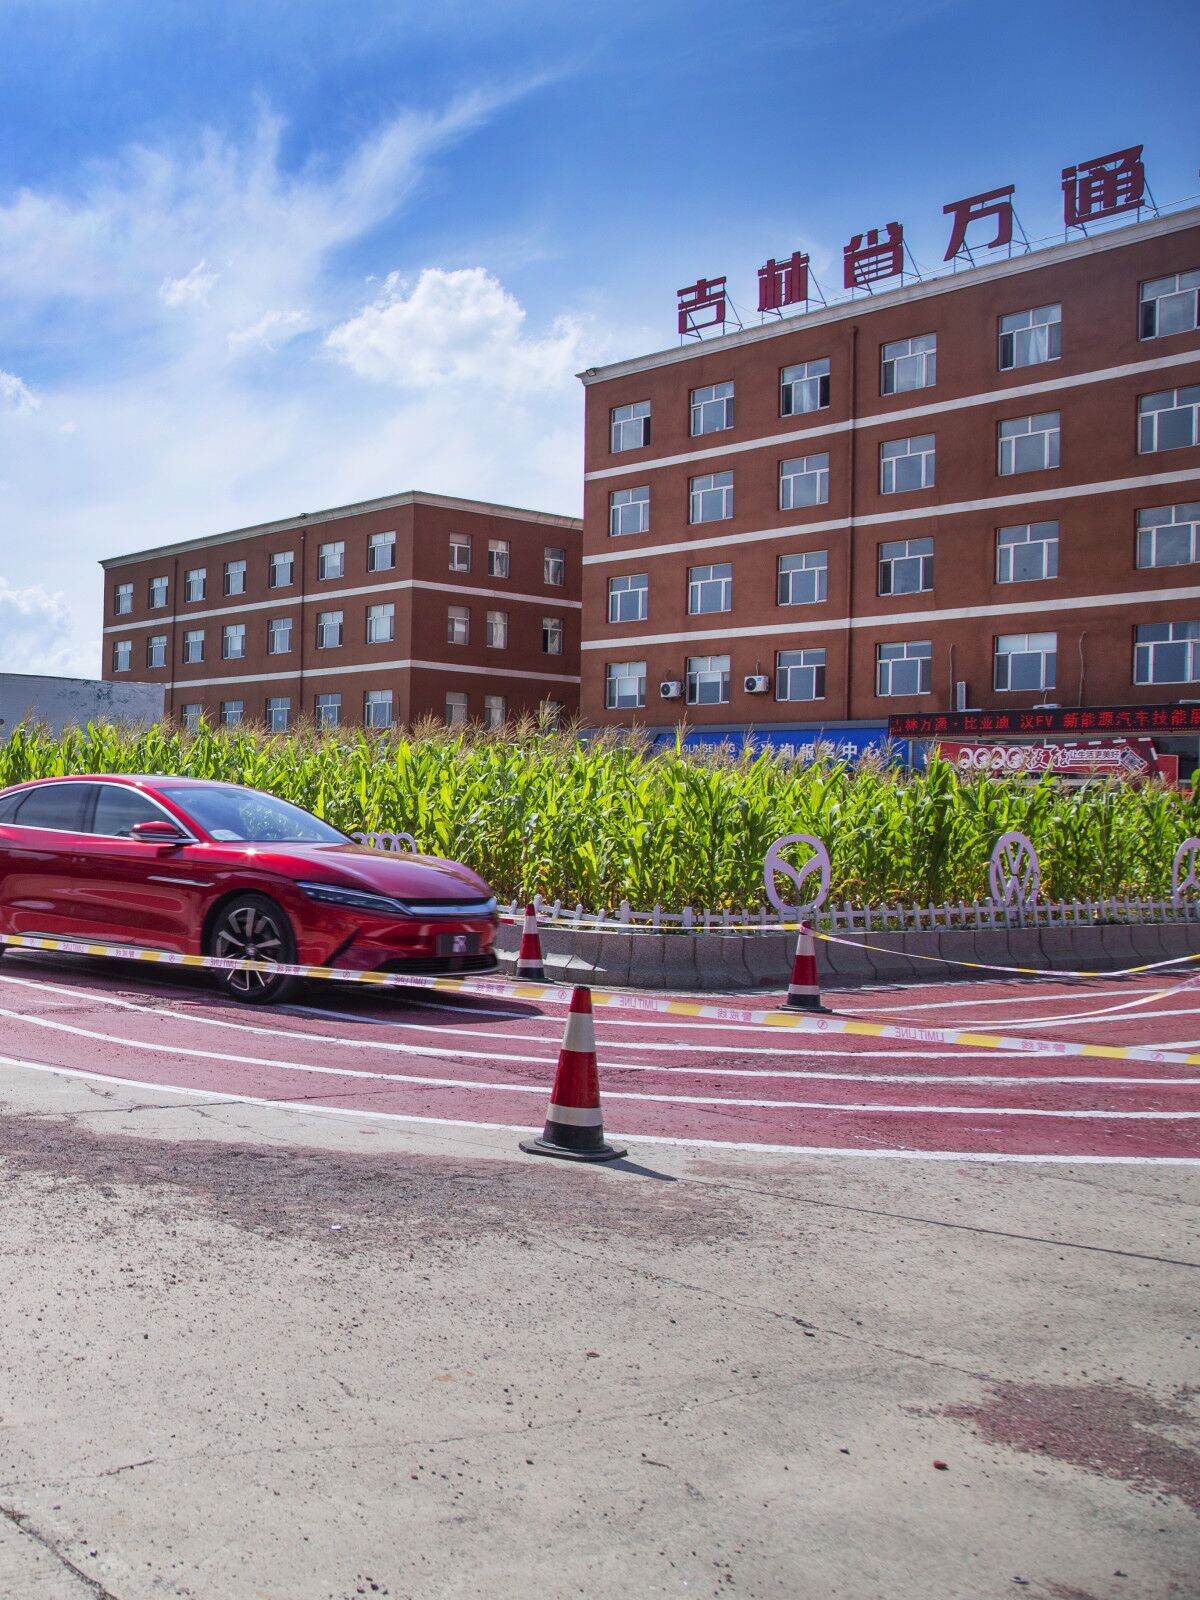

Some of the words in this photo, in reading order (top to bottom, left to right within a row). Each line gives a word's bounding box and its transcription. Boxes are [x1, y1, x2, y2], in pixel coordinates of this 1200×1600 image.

[676, 144, 1145, 335] 吉林省万通
